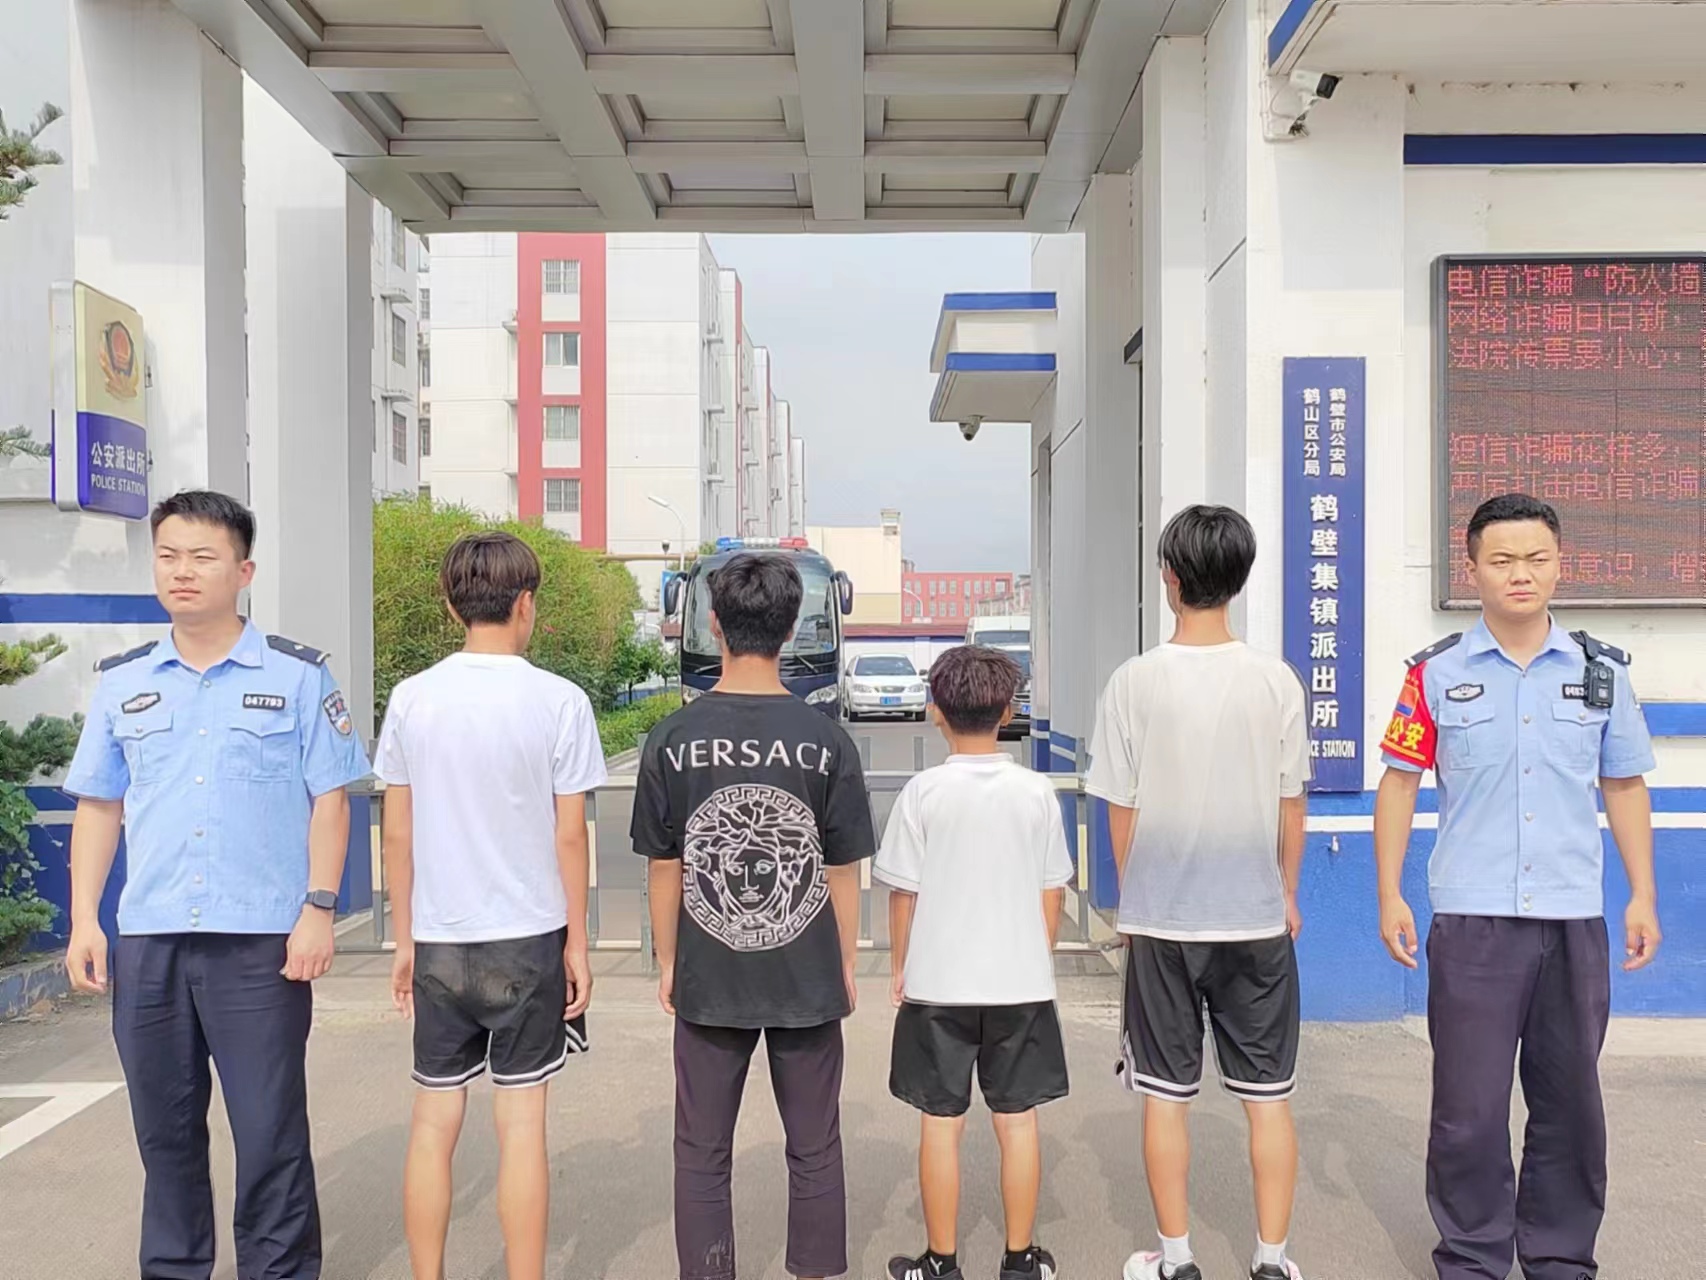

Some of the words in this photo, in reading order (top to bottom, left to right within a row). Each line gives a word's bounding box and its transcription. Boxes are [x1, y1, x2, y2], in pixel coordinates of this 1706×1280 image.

[1303, 387, 1321, 476] 鹤山区分局
[1328, 387, 1347, 476] 鹤壁市公安局
[91, 440, 146, 477] 公安派出所
[91, 473, 116, 491] POLICE
[118, 478, 146, 498] STATION
[1449, 467, 1700, 501] 严厉打击电信诈骗
[1310, 494, 1339, 729] 鹤壁集镇派出所
[1322, 740, 1356, 758] STATION
[1385, 715, 1426, 750] 公安
[665, 738, 832, 777] VERSACE
